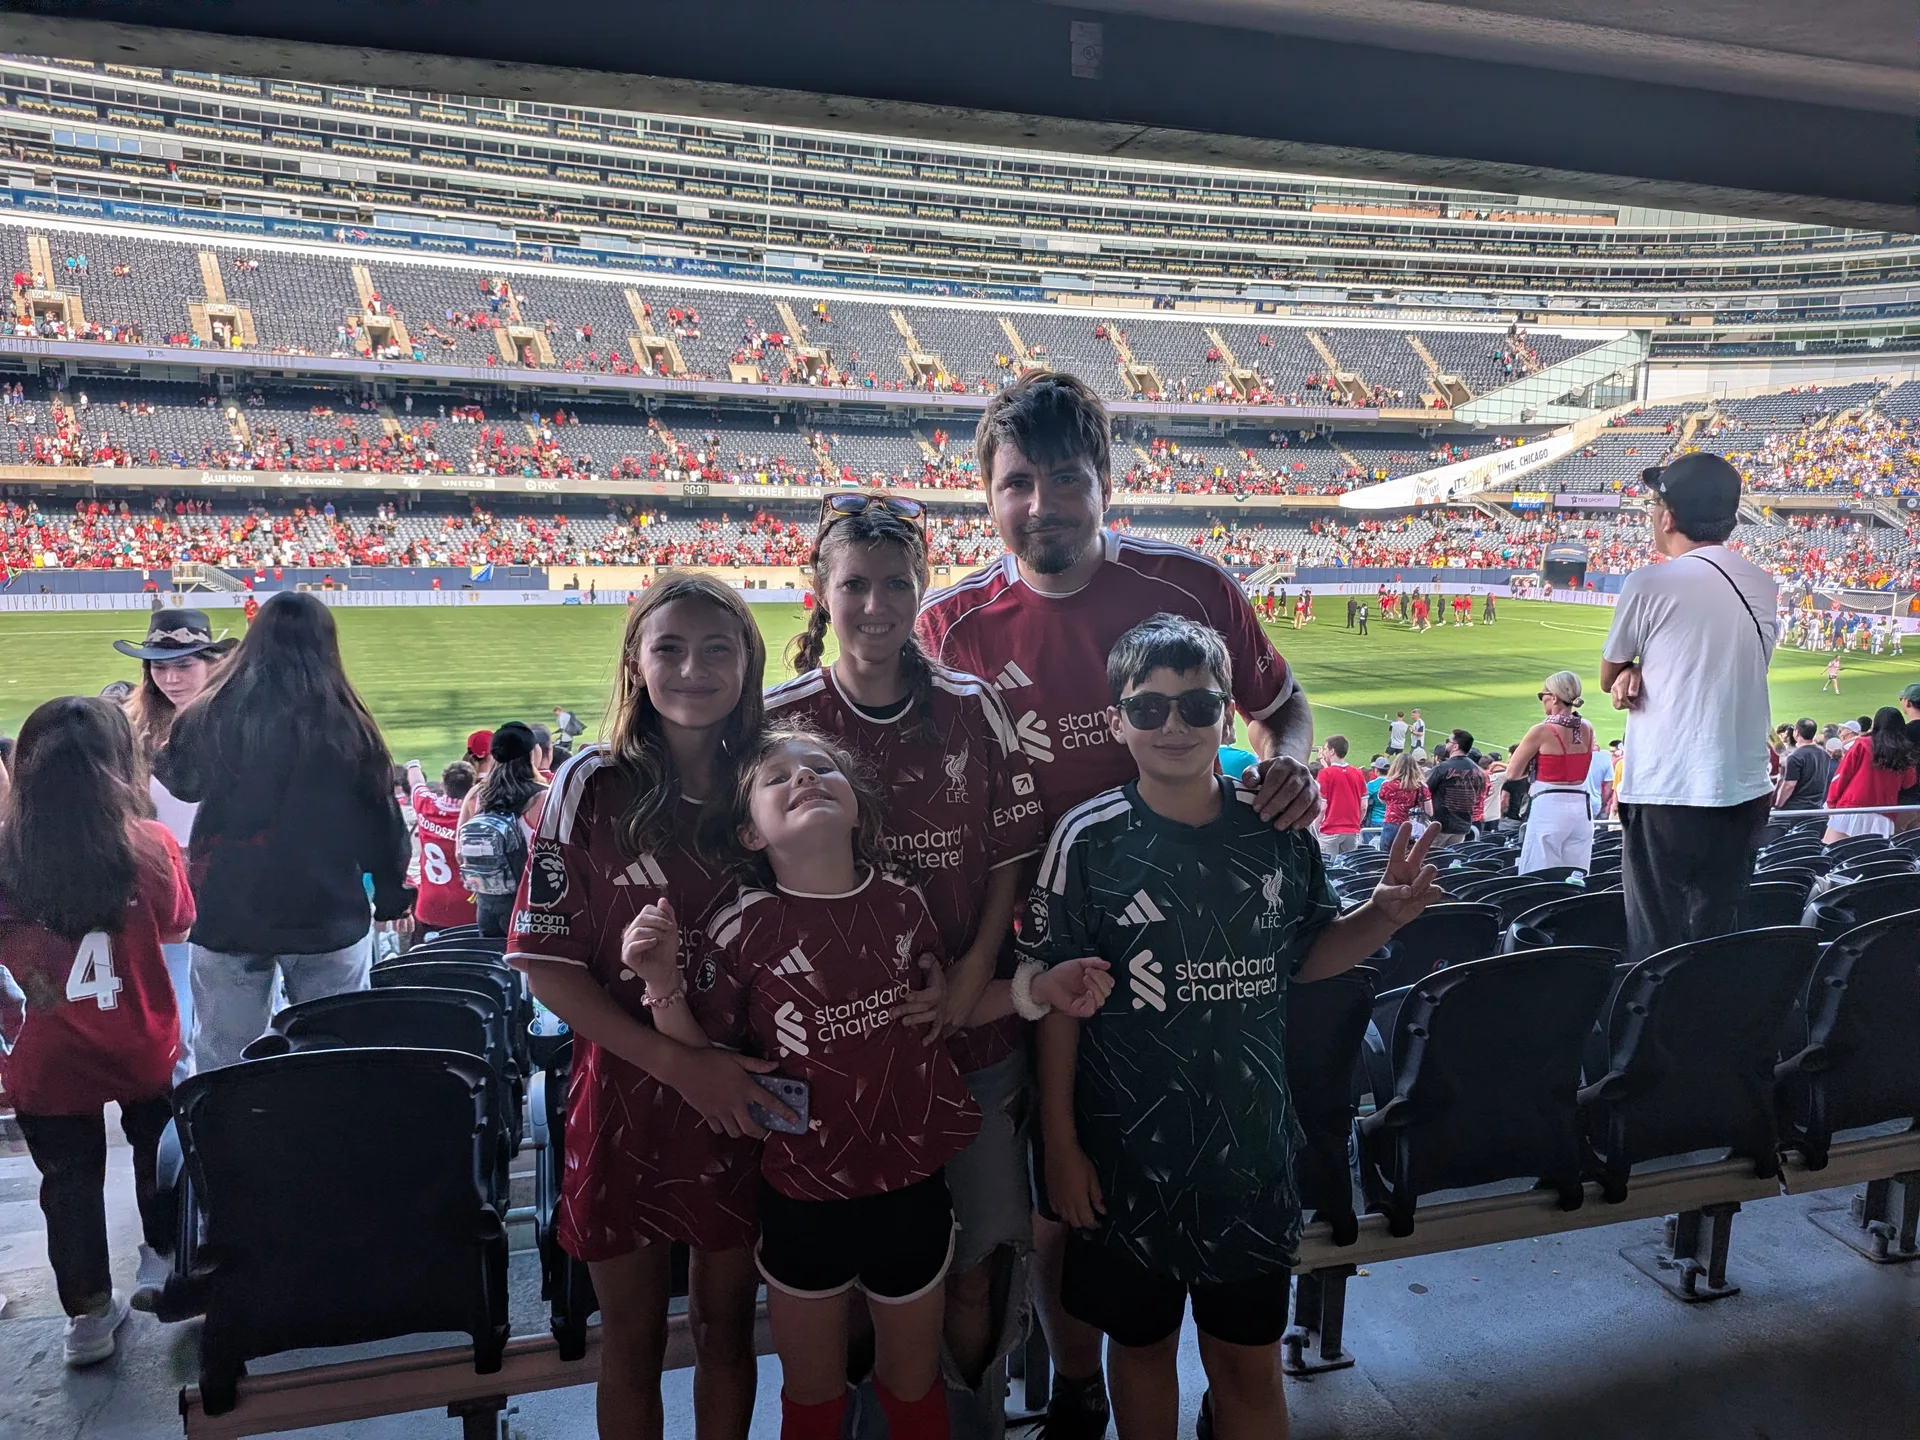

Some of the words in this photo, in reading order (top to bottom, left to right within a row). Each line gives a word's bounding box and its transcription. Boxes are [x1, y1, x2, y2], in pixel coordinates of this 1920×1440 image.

[1497, 460, 1517, 475] TIME,
[1520, 449, 1548, 467] CHICAGO
[201, 472, 228, 484] BLUE
[228, 474, 255, 483] MOON
[294, 475, 343, 486] Advocate
[441, 480, 483, 488] UNITED
[537, 481, 560, 490] PNC
[684, 485, 708, 495] 90:00
[738, 486, 786, 497] SOLDIER
[791, 487, 821, 498] FIELD
[1124, 494, 1172, 504] ticketmaster
[86, 594, 100, 609] FC
[110, 594, 117, 608] V
[394, 592, 407, 605] FC
[415, 592, 421, 605] V
[428, 591, 464, 606] LEEDS
[424, 842, 452, 884] 8
[530, 912, 565, 925] room
[527, 923, 570, 936] racism
[66, 931, 123, 1011] 4
[1175, 952, 1276, 981] standard
[1176, 972, 1278, 1002] chartered
[814, 978, 911, 1026] standard
